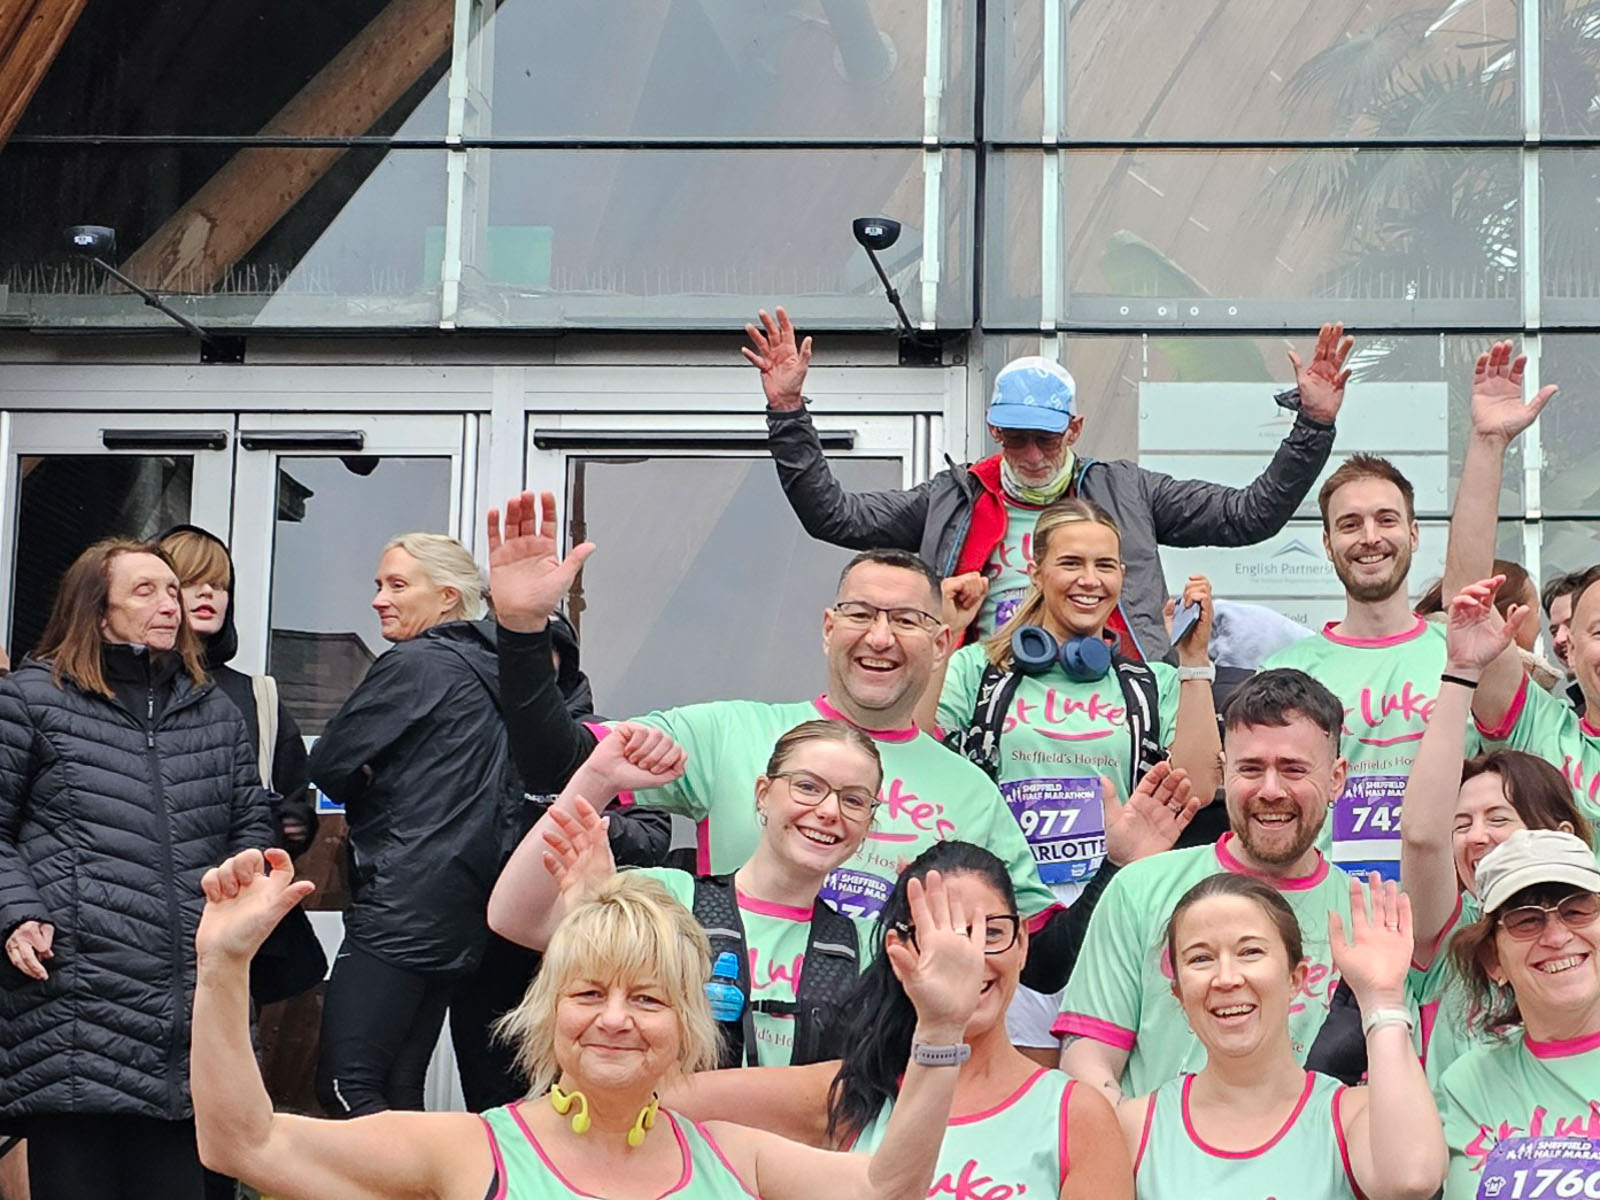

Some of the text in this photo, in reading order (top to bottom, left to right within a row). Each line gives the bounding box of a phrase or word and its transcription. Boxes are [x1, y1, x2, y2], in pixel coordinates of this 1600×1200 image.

[1235, 563, 1278, 577] English
[1043, 687, 1126, 727] Luke
[1011, 749, 1121, 769] Sheffield's Hospice
[1021, 783, 1062, 793] SHEFFIELD
[1021, 790, 1096, 801] HALF MARATHON
[1020, 808, 1081, 837] 977
[837, 881, 863, 895] HALF
[841, 872, 888, 892] SHEFFIELD
[1536, 1140, 1593, 1152] SHEFFIELD
[1533, 1149, 1562, 1161] HALF
